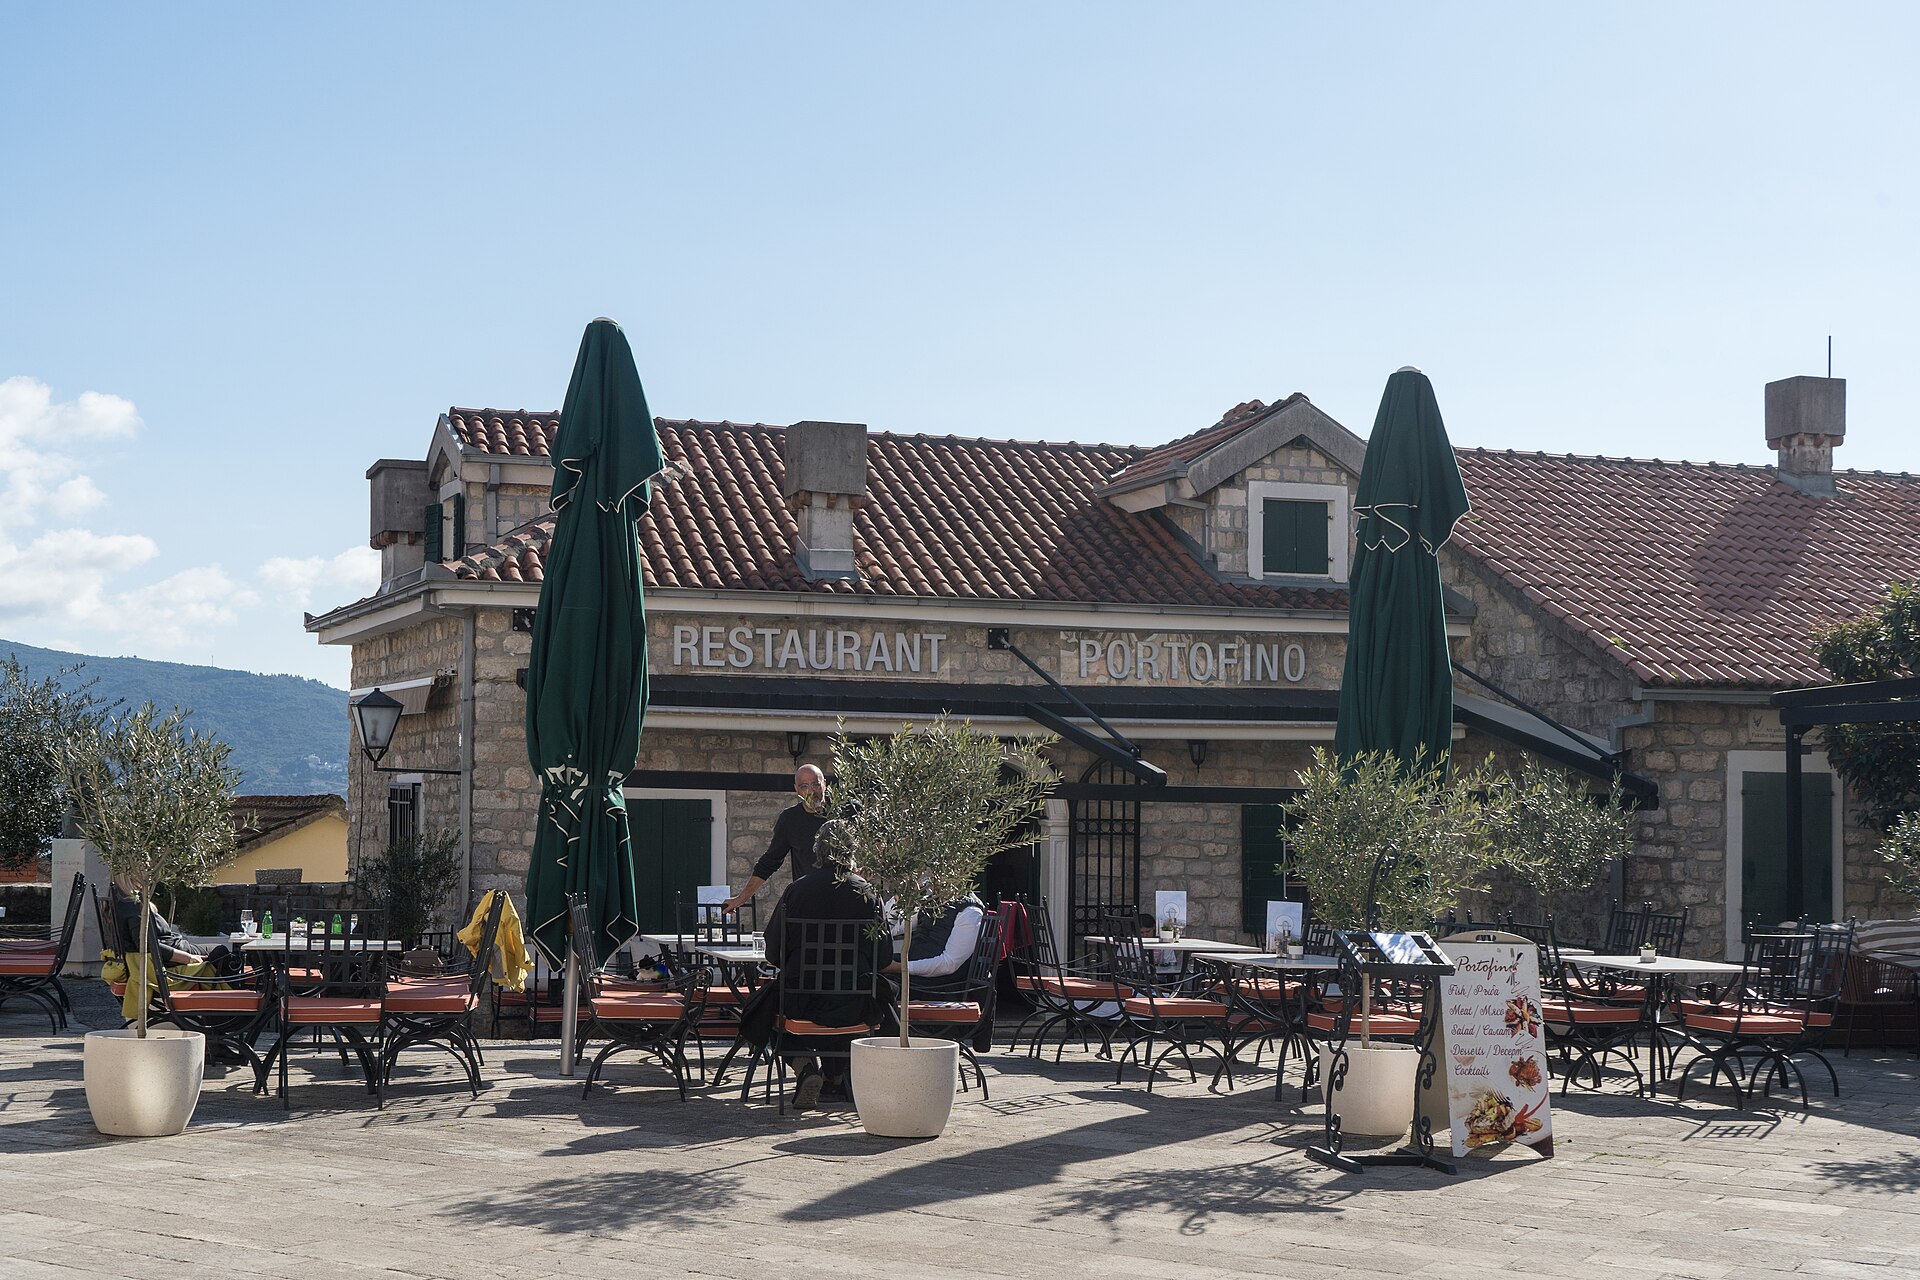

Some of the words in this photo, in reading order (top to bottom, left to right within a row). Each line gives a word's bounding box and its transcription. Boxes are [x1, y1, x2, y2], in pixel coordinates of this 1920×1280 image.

[673, 625, 947, 673] RESTAURANT
[1079, 639, 1306, 683] PORTOFINO
[1448, 984, 1466, 996] Fish
[1449, 1004, 1473, 1016] Meat
[1451, 1023, 1476, 1036] Salad
[1453, 1043, 1485, 1056] Desserts
[1454, 1064, 1491, 1079] Cocktails
